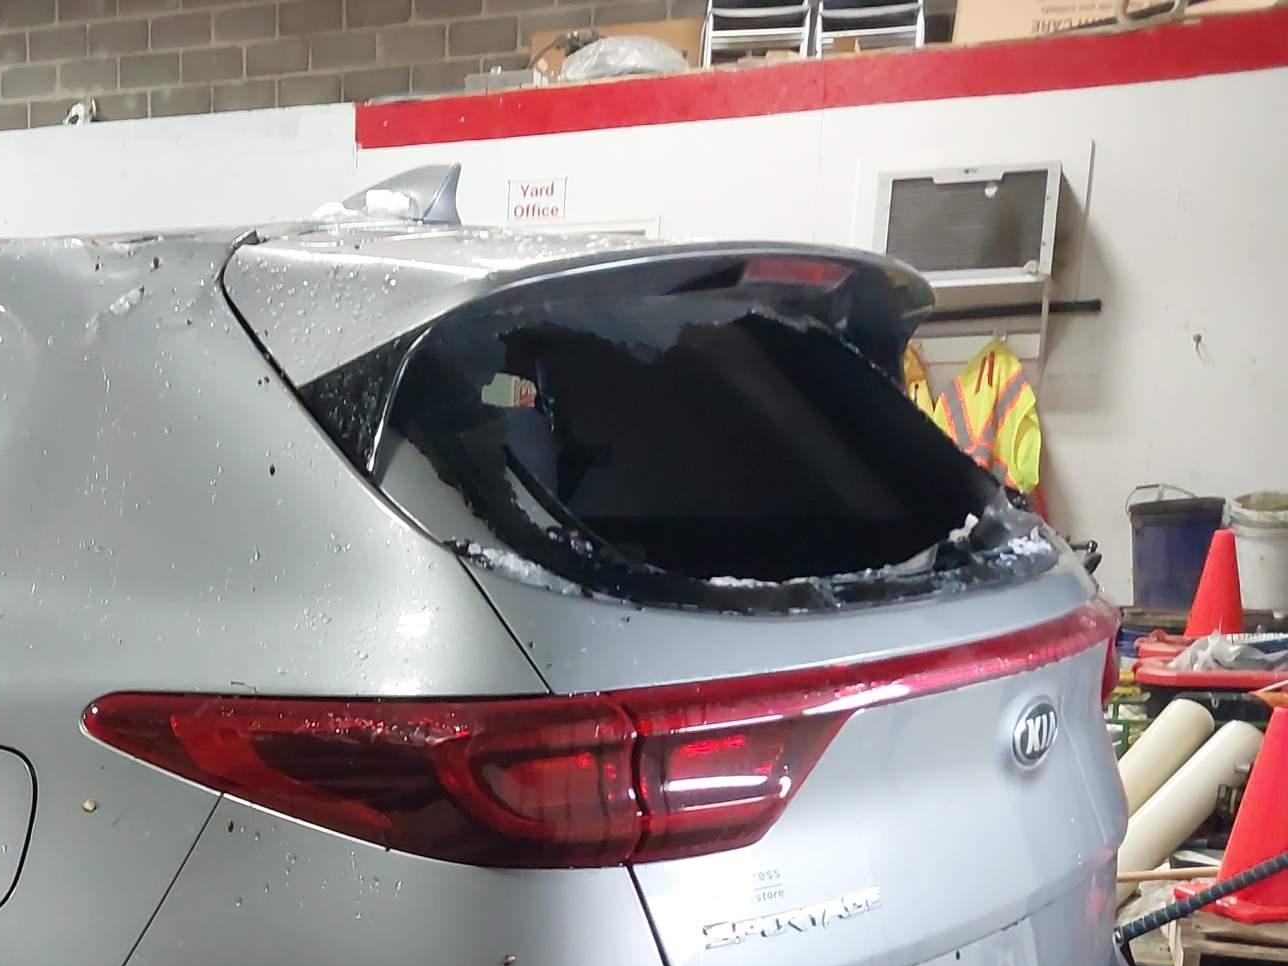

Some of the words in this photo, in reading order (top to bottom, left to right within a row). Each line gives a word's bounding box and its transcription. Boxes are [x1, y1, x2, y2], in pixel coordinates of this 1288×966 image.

[520, 181, 555, 198] Yard
[514, 202, 559, 218] Office
[1025, 710, 1056, 754] KIA
